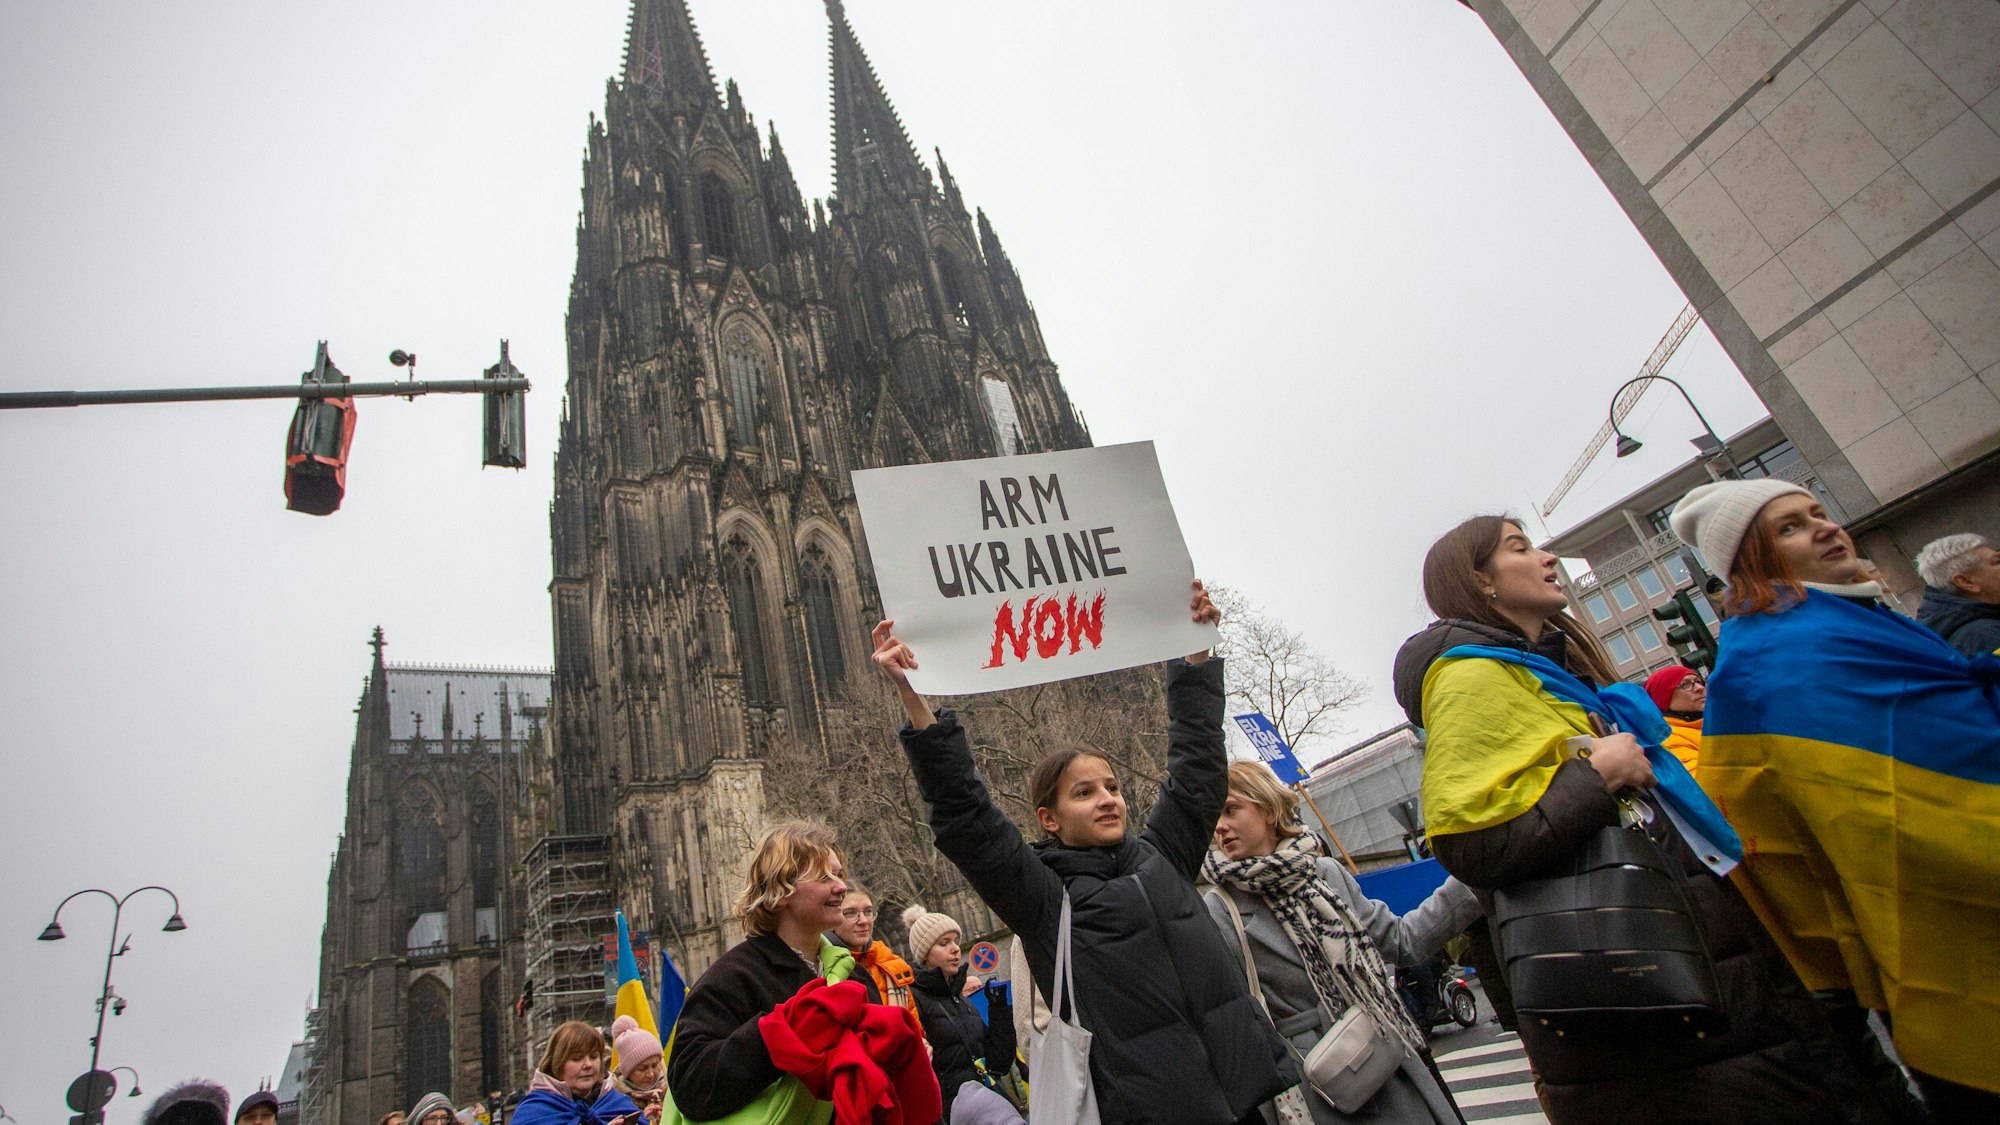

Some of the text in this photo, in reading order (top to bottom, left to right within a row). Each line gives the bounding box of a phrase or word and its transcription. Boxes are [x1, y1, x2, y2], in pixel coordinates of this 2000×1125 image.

[980, 473, 1070, 531] ARM
[928, 526, 1127, 598] UKRAINE
[981, 588, 1107, 669] NOW
[1237, 718, 1260, 733] EU
[1248, 730, 1281, 748] KRA
[1258, 744, 1286, 761] INE
